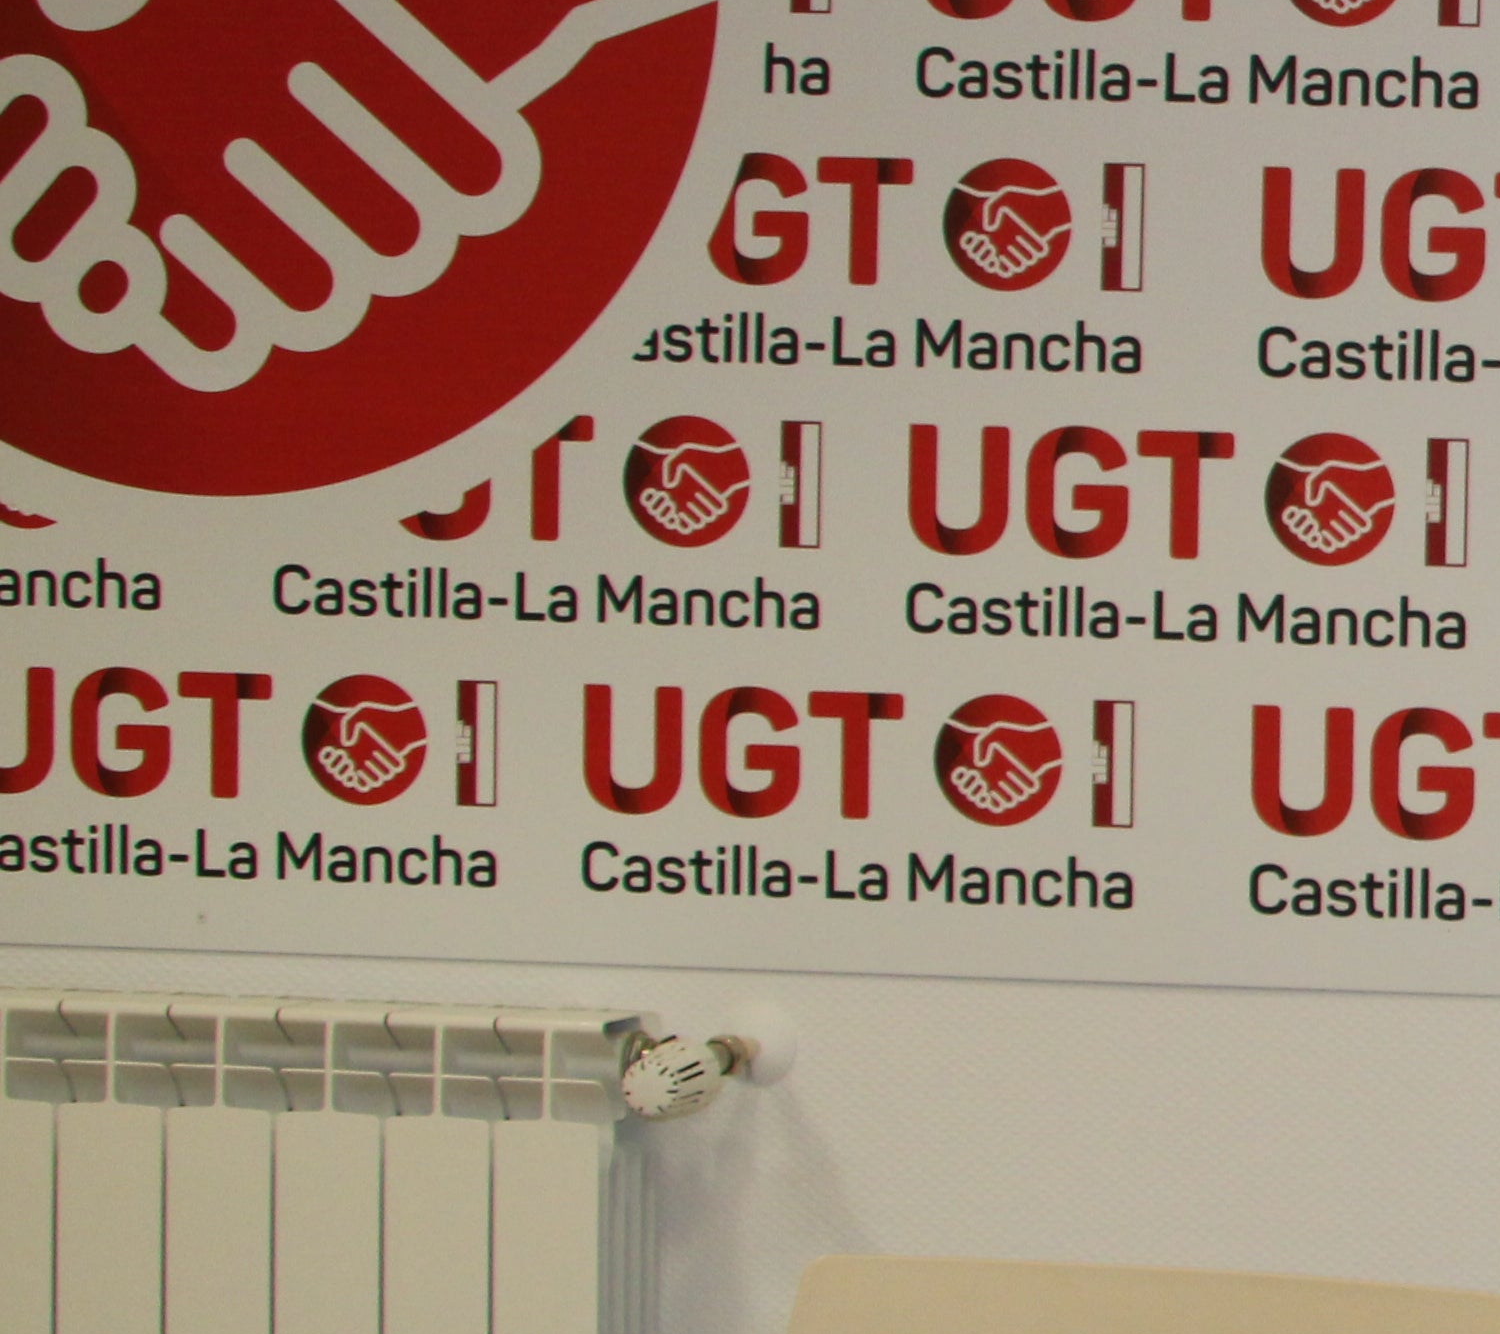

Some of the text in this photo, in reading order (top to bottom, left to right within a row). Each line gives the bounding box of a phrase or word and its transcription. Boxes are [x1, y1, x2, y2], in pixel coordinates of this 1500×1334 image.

[917, 47, 1479, 109] Castilla-La Mancha
[916, 318, 1142, 374] Mancha
[909, 424, 1235, 559] UGT
[274, 564, 820, 630] Castilla-La Mancha
[907, 582, 1466, 649] Castilla-La Mancha
[584, 684, 904, 819] UGT
[278, 831, 497, 887] Mancha
[583, 841, 1133, 909] Castilla-La Mancha
